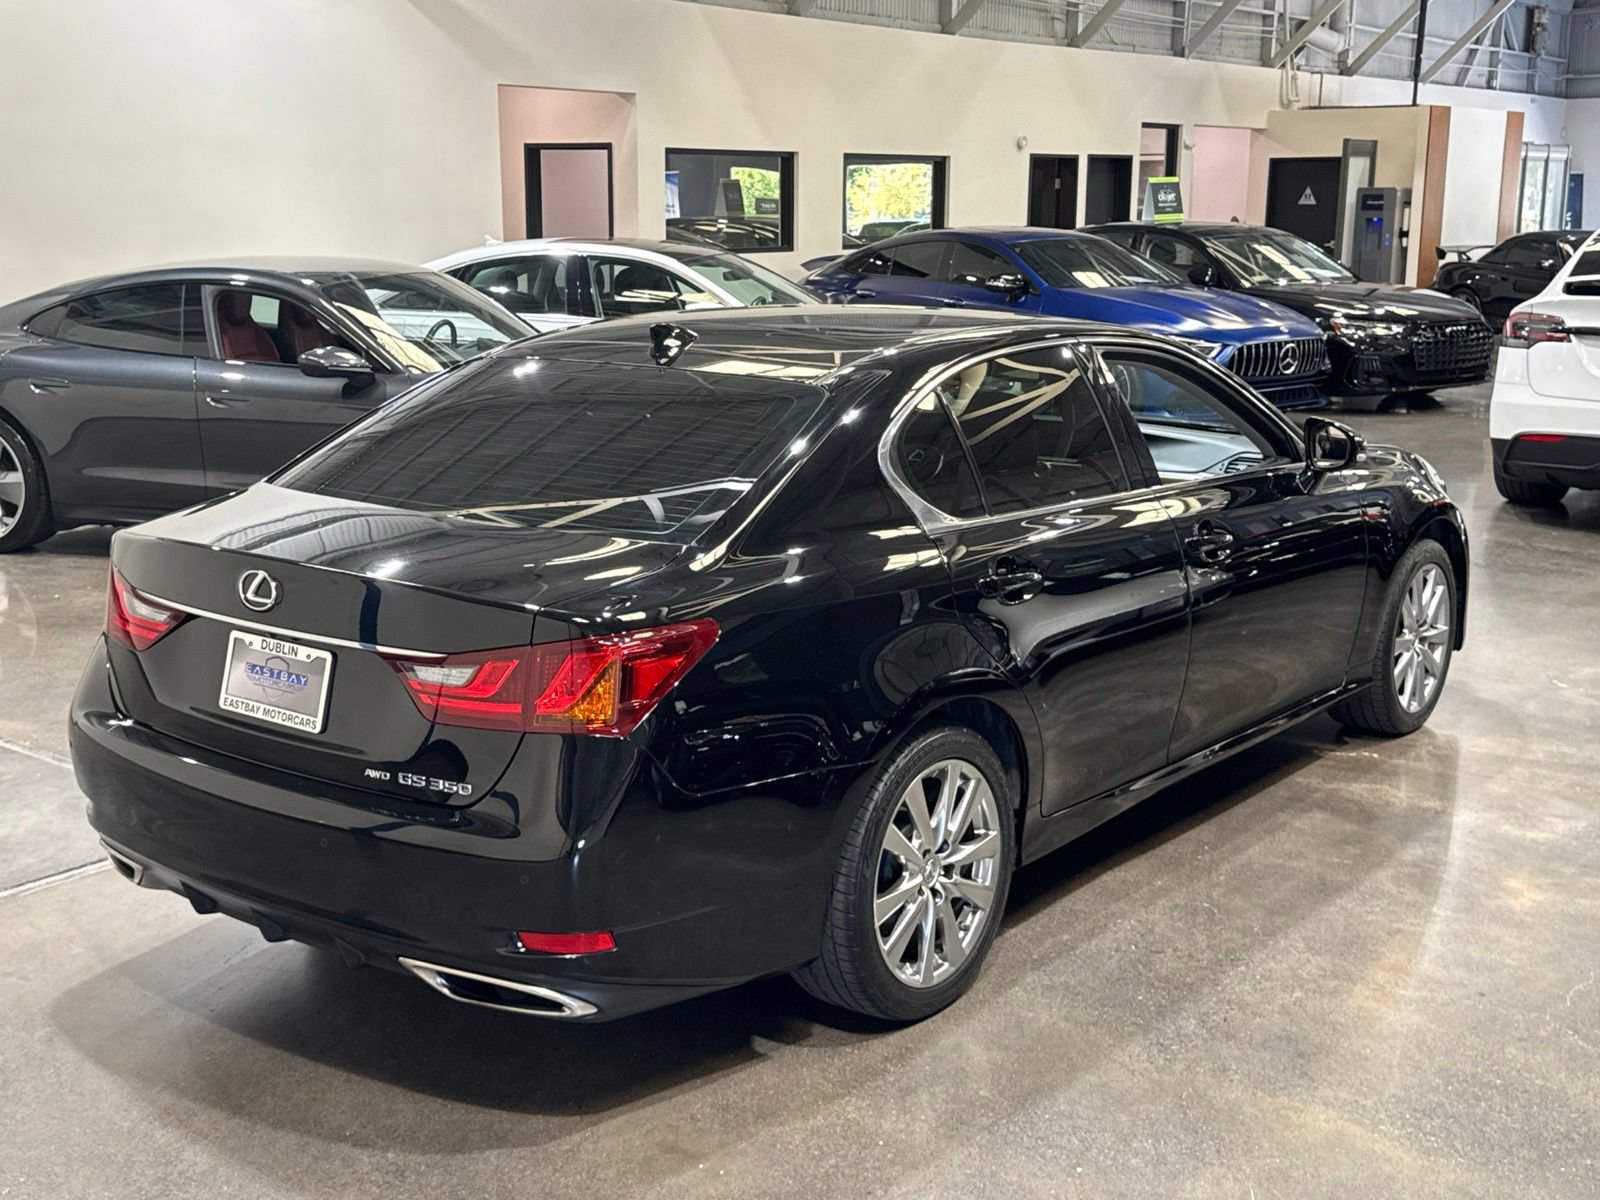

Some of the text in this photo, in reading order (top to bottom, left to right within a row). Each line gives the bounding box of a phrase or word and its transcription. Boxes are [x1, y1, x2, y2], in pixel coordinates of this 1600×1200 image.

[261, 639, 299, 657] DUBLIN
[246, 663, 308, 686] EASTBAY
[254, 676, 297, 691] MOTORCARS
[223, 697, 317, 730] EASTBAY MOTORCARS
[364, 768, 472, 796] AWD GS 350
